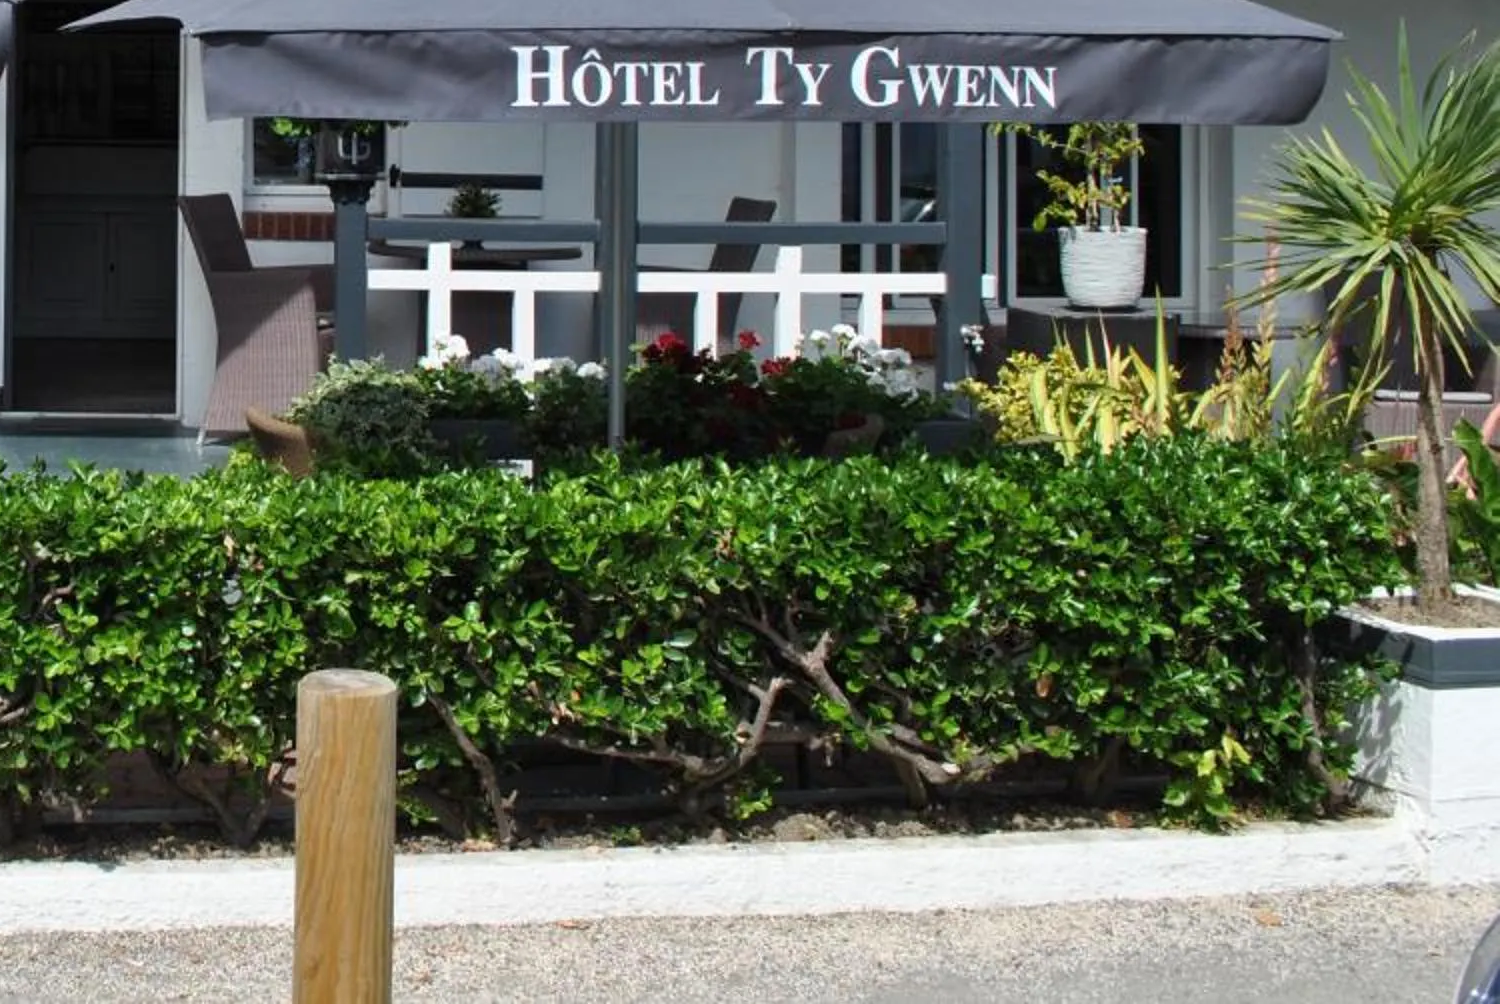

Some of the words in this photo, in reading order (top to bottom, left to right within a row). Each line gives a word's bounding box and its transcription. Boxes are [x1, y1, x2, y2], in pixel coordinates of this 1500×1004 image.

[510, 45, 719, 107] HÔTEL
[746, 47, 830, 105] TY
[851, 46, 1057, 109] GWENN
